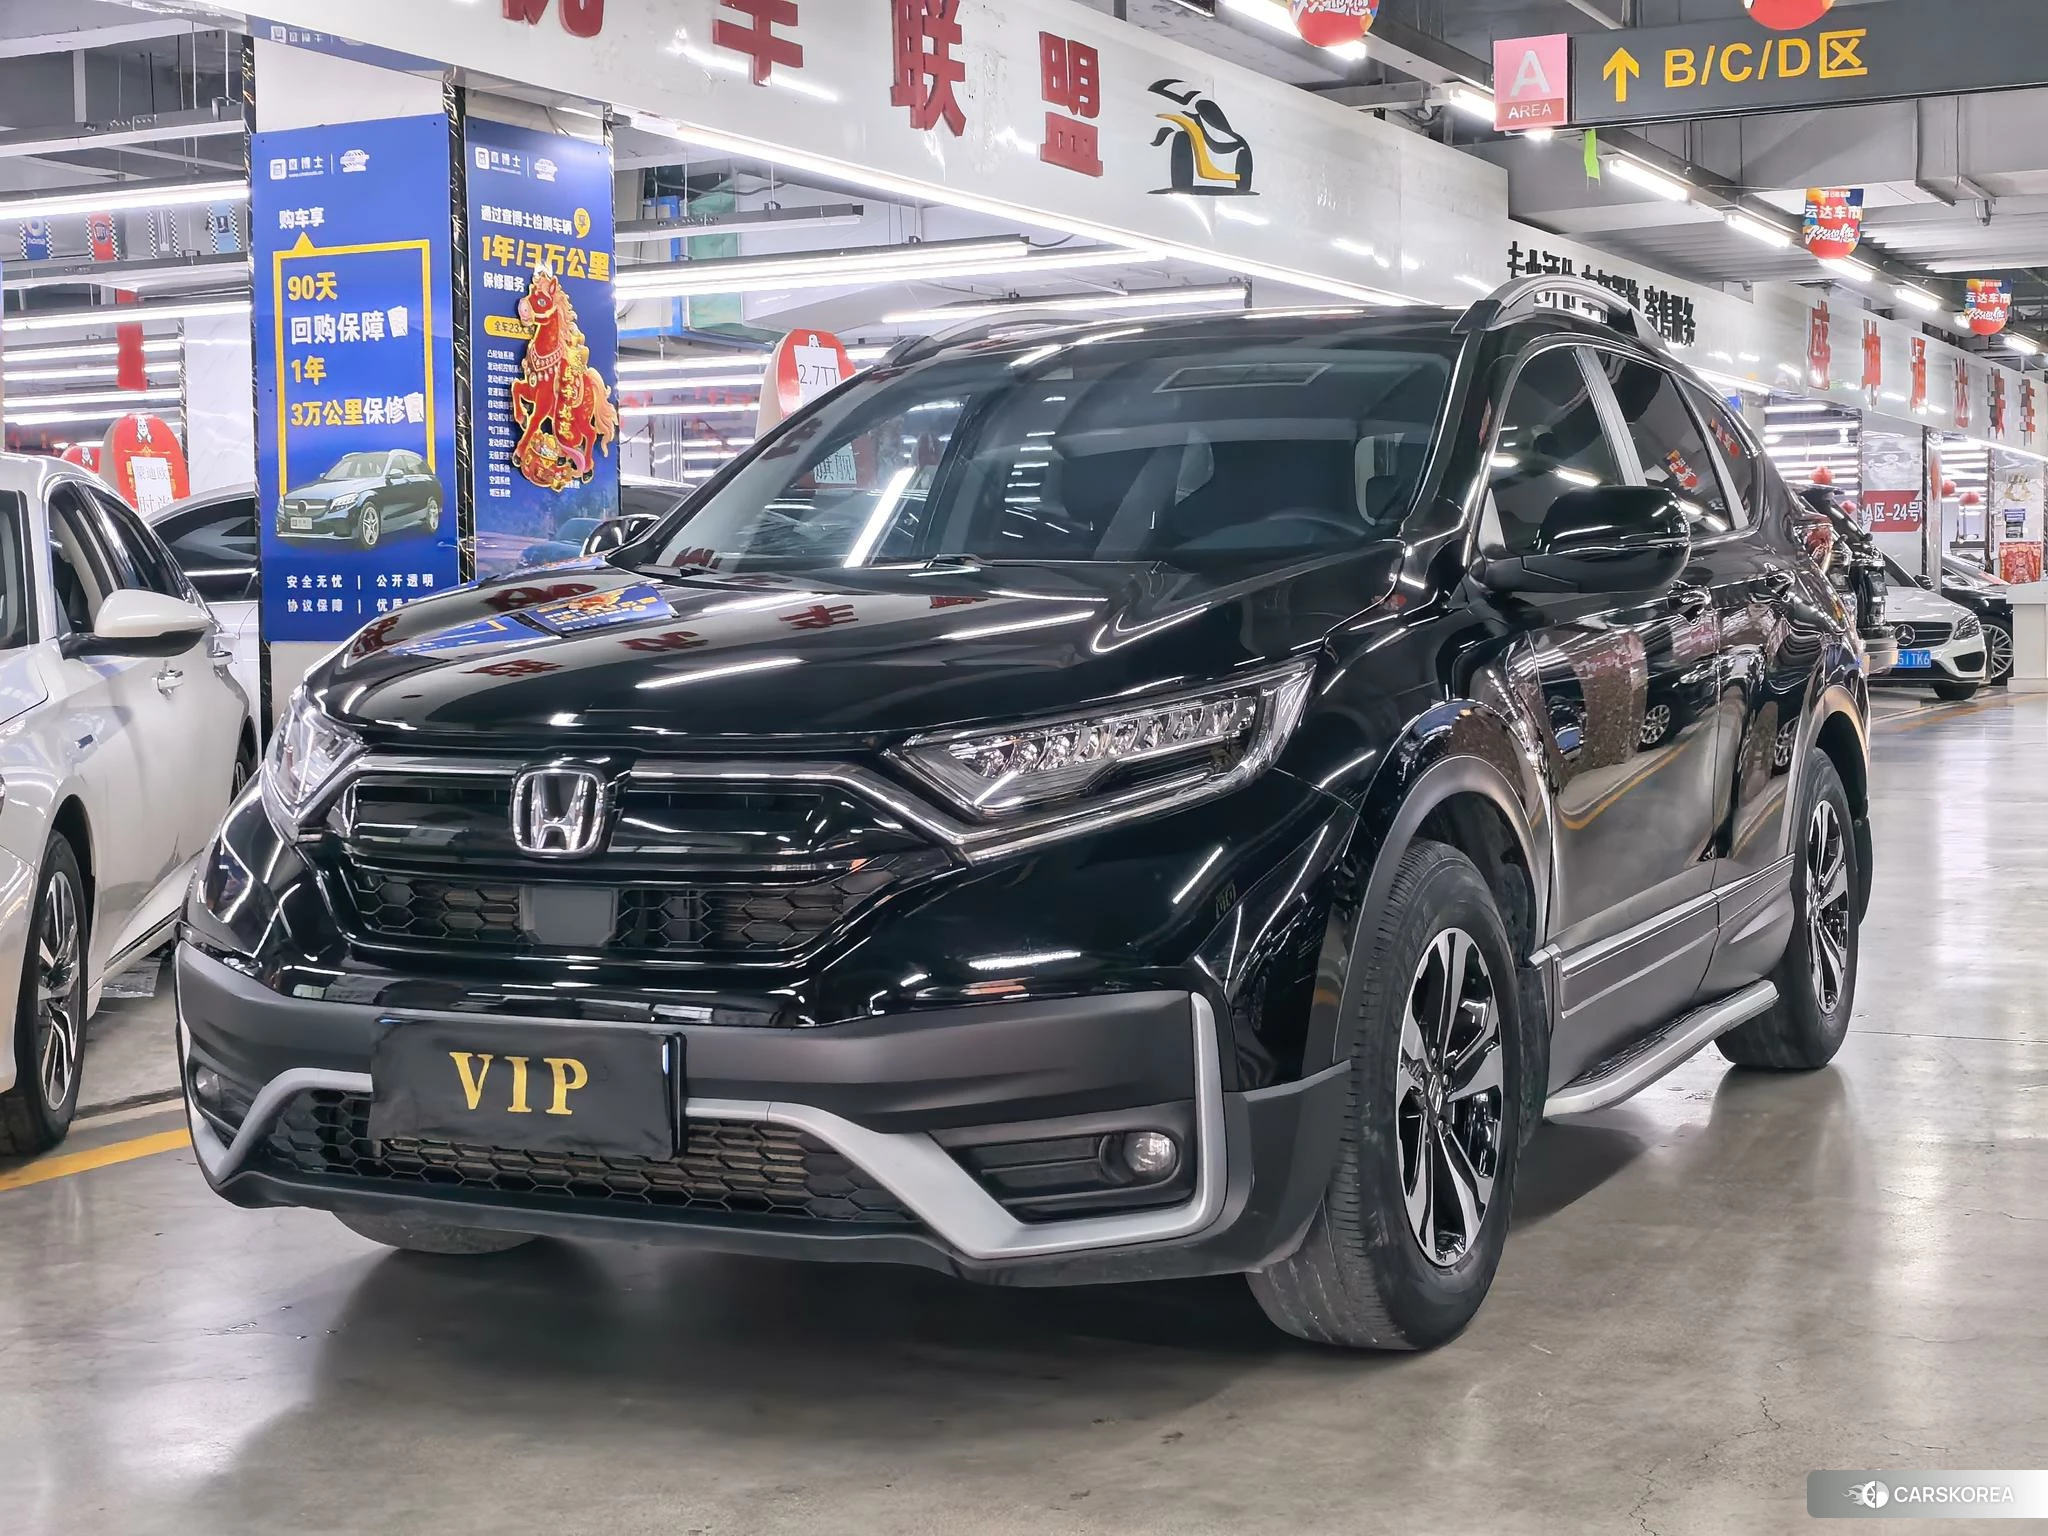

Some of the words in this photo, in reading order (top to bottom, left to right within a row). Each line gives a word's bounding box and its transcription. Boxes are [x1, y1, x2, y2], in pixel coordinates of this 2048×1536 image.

[1665, 29, 1868, 88] B/C/D区
[1511, 50, 1551, 96] A
[1508, 103, 1552, 119] AREA
[279, 206, 325, 229] 购车享
[1805, 204, 1863, 221] 云达车市
[482, 235, 610, 282] 1年/3万公里
[288, 271, 338, 301] 90天
[483, 272, 525, 293] 保修服务
[1965, 291, 2012, 305] 云达车市
[290, 310, 385, 345] 回购保障
[291, 355, 327, 386] 1年
[291, 395, 406, 427] 3万公里保修
[1864, 501, 1920, 522] A区-24号
[286, 574, 343, 589] 安全无忧
[376, 574, 435, 588] 公开透明
[287, 598, 344, 613] 协议保障
[449, 1052, 588, 1115] VIP
